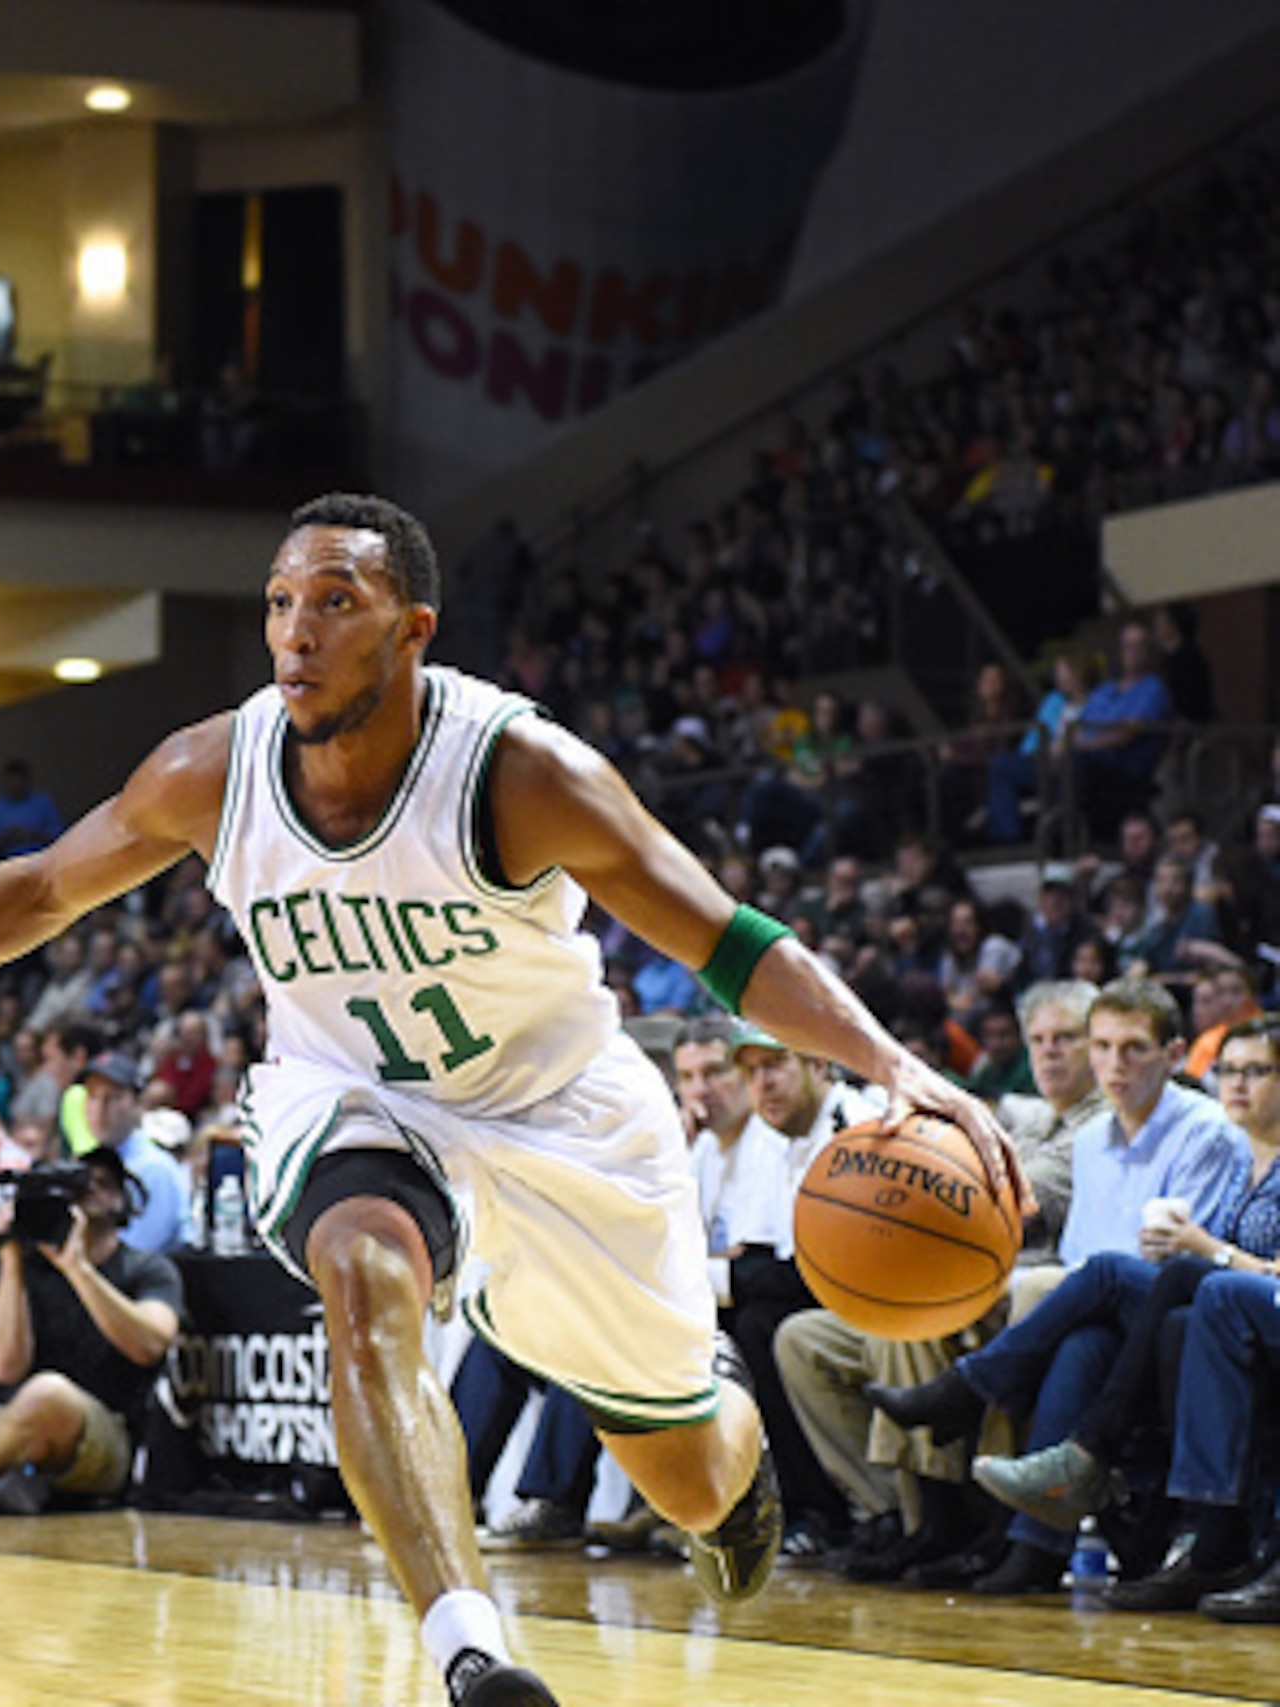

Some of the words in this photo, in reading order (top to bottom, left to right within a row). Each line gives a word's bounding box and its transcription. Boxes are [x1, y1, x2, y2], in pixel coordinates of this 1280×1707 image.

[250, 889, 499, 982] CELTICS
[345, 983, 495, 1081] 11
[828, 1146, 978, 1217] SPALDING
